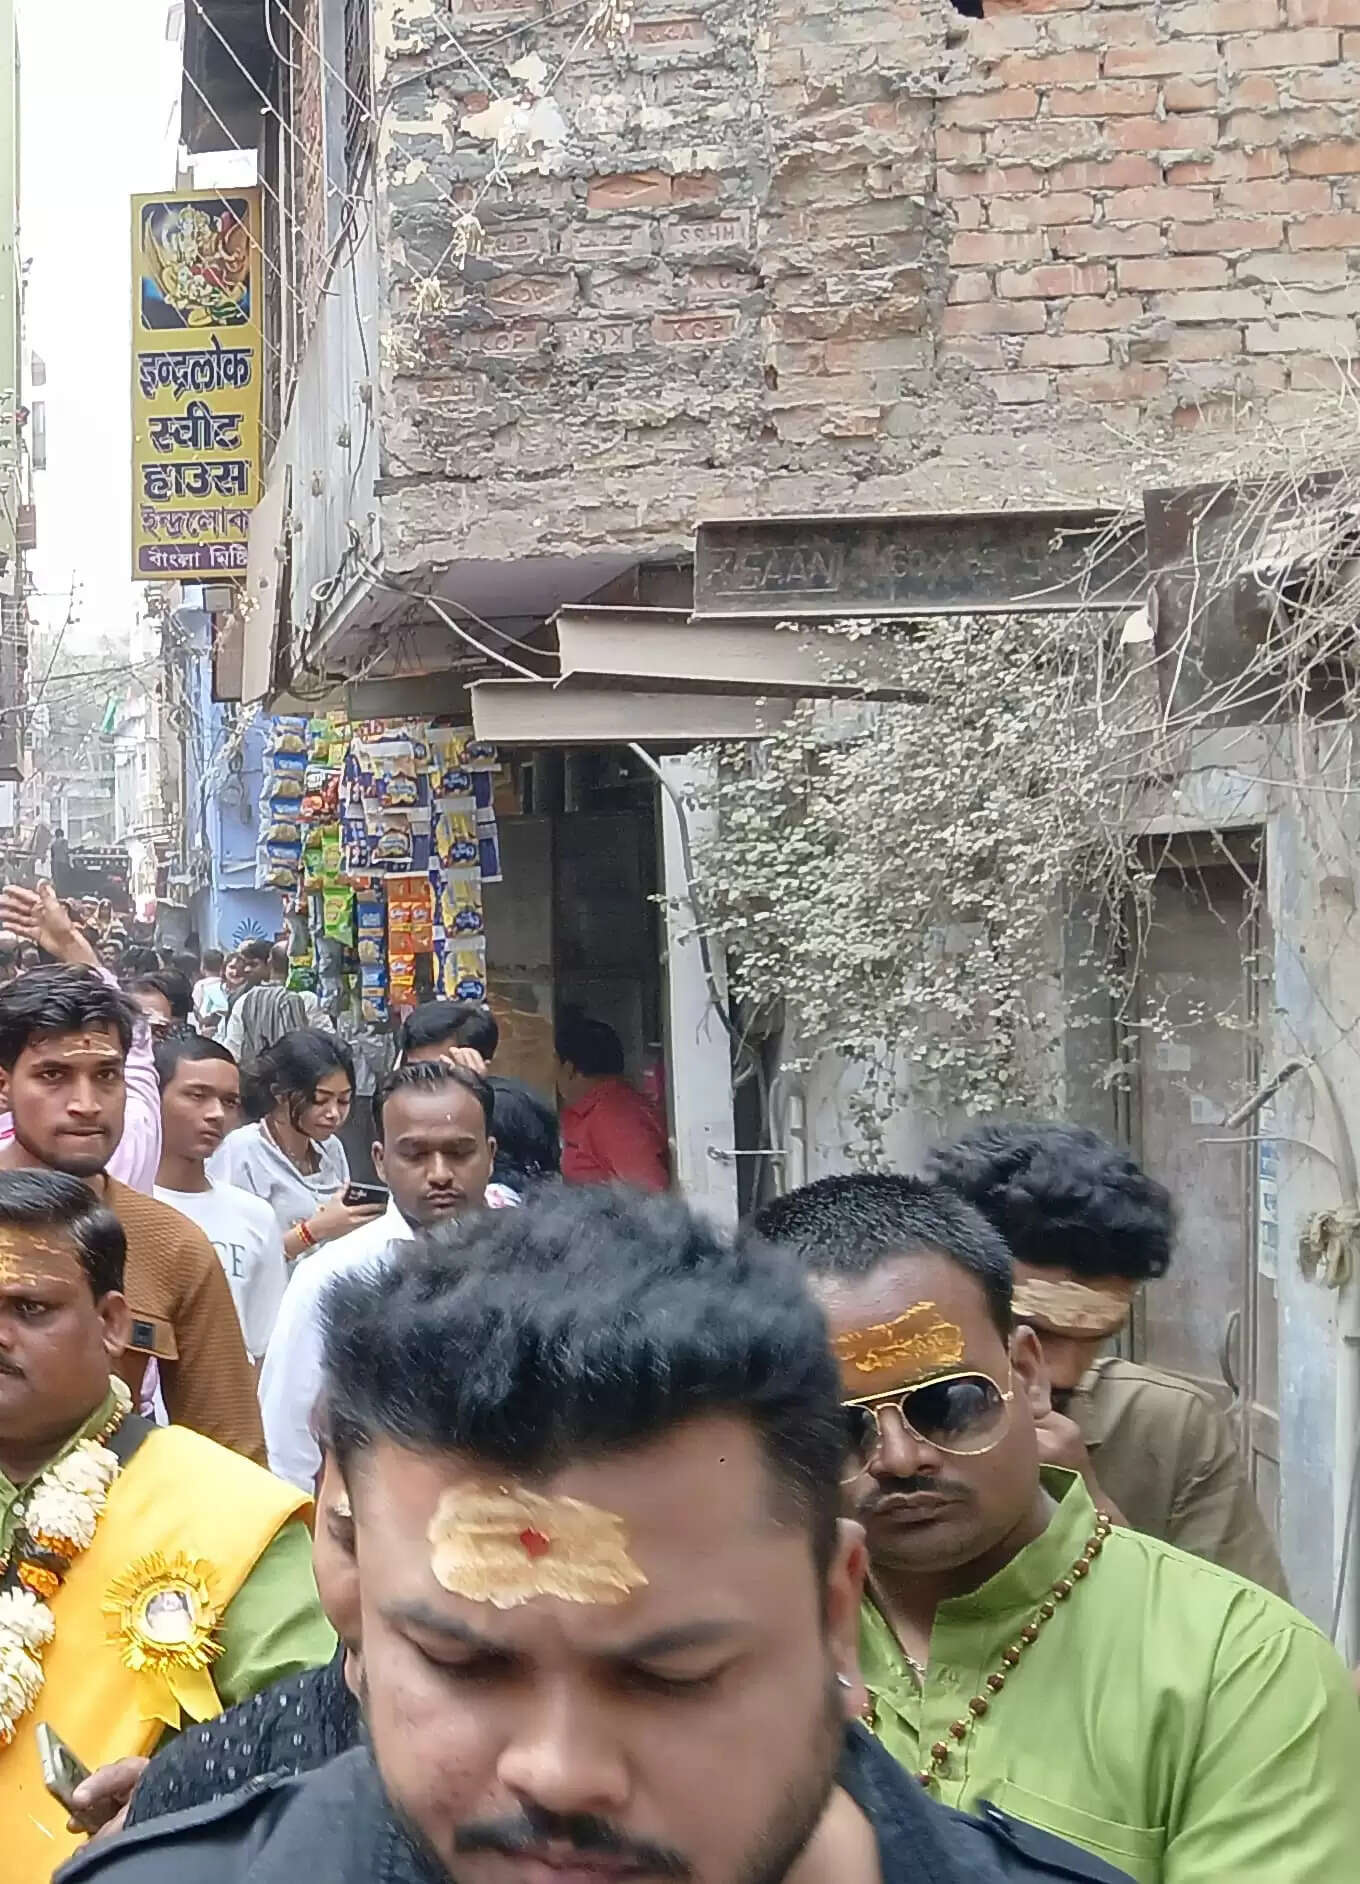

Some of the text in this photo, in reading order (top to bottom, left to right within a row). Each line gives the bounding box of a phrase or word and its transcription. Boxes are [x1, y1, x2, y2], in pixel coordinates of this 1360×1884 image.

[138, 334, 253, 401] इन्द्रलोक
[148, 400, 243, 453] स्वीट
[141, 460, 251, 502] हाउस
